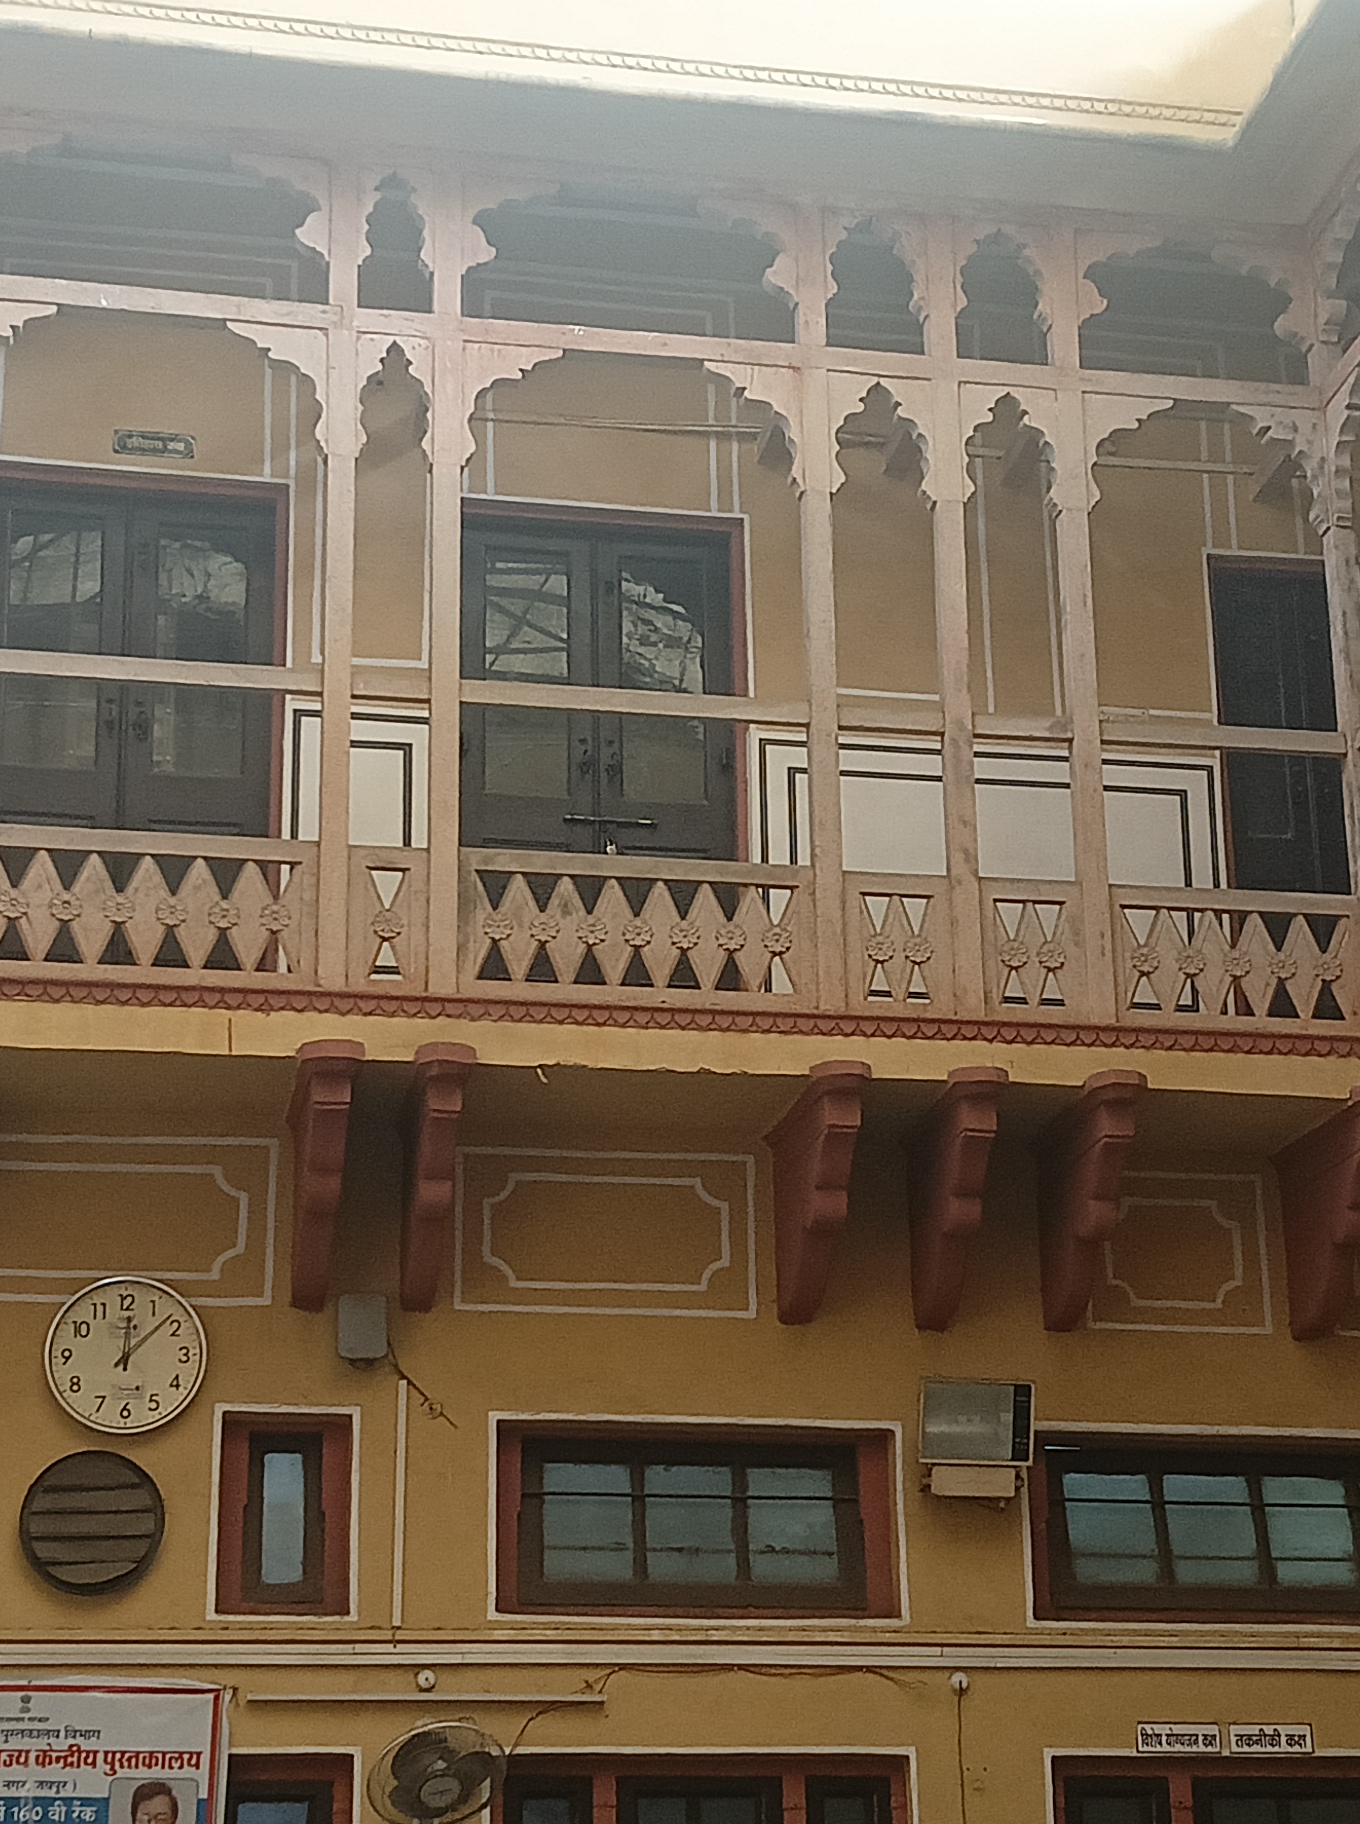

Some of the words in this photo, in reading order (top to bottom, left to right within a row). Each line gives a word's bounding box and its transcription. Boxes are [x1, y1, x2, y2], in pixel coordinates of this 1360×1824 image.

[118, 1294, 135, 1311] 12
[150, 1300, 156, 1317] 1
[91, 1303, 106, 1320] 11
[72, 1321, 90, 1338] 10
[169, 1319, 181, 1337] 2
[61, 1348, 72, 1365] 9
[178, 1346, 190, 1364] 3
[69, 1376, 81, 1393] 8
[169, 1374, 181, 1391] 4
[94, 1395, 107, 1414] 7
[120, 1402, 131, 1419] 6
[148, 1393, 160, 1411] 5
[1234, 1728, 1281, 1749] तकनीकी
[1285, 1733, 1306, 1749] कक्ष
[35, 1743, 100, 1770] केन्द्रीय
[103, 1750, 203, 1776] पुस्तकालय
[11, 1806, 43, 1821] 160
